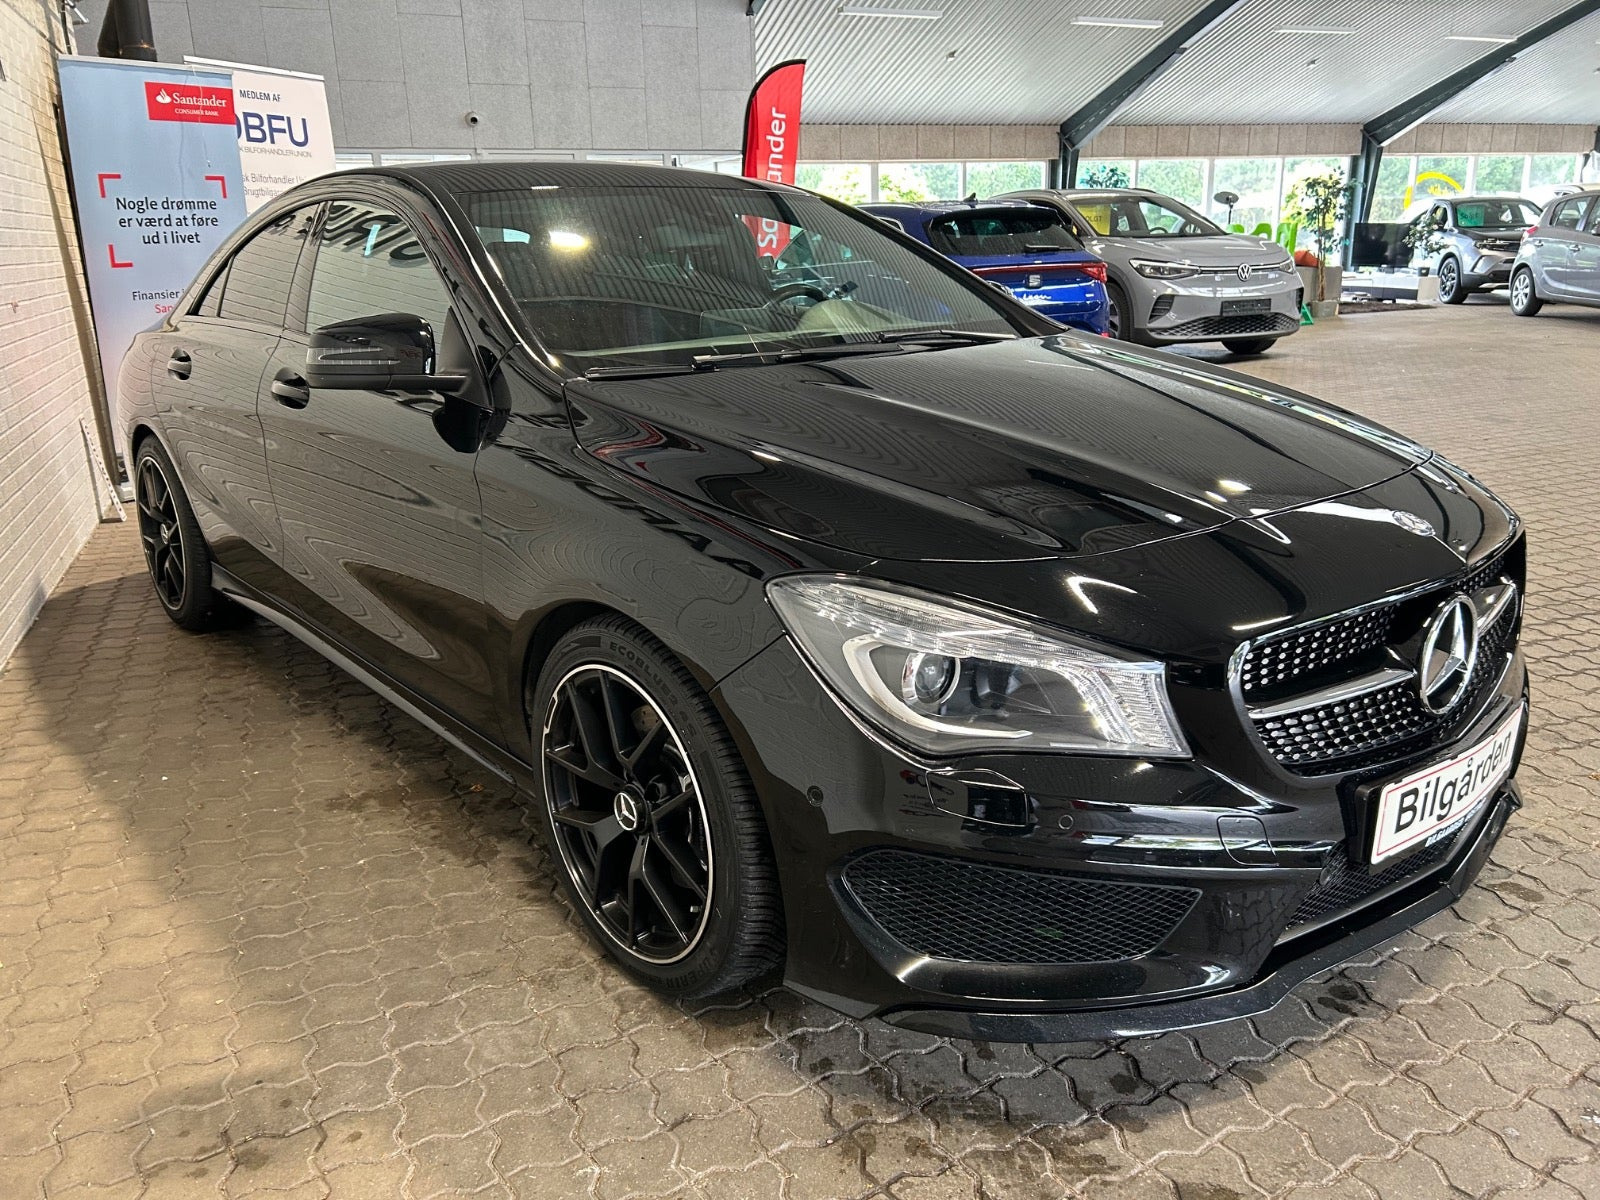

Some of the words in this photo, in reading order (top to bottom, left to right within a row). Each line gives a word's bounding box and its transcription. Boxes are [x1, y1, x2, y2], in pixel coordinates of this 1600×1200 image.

[172, 92, 227, 107] Santander
[239, 89, 271, 101] MEDLEM
[272, 94, 281, 102] AF
[174, 108, 205, 116] CONSUMER
[116, 196, 158, 214] Nogle
[161, 196, 217, 210] drømme
[118, 217, 133, 228] er
[135, 214, 172, 227] værd
[175, 215, 189, 227] at
[191, 213, 219, 227] føre
[142, 231, 160, 245] ud
[163, 231, 168, 244] i
[171, 231, 201, 244] livet
[132, 290, 180, 301] Finansier
[1393, 731, 1512, 835] Bilgården
